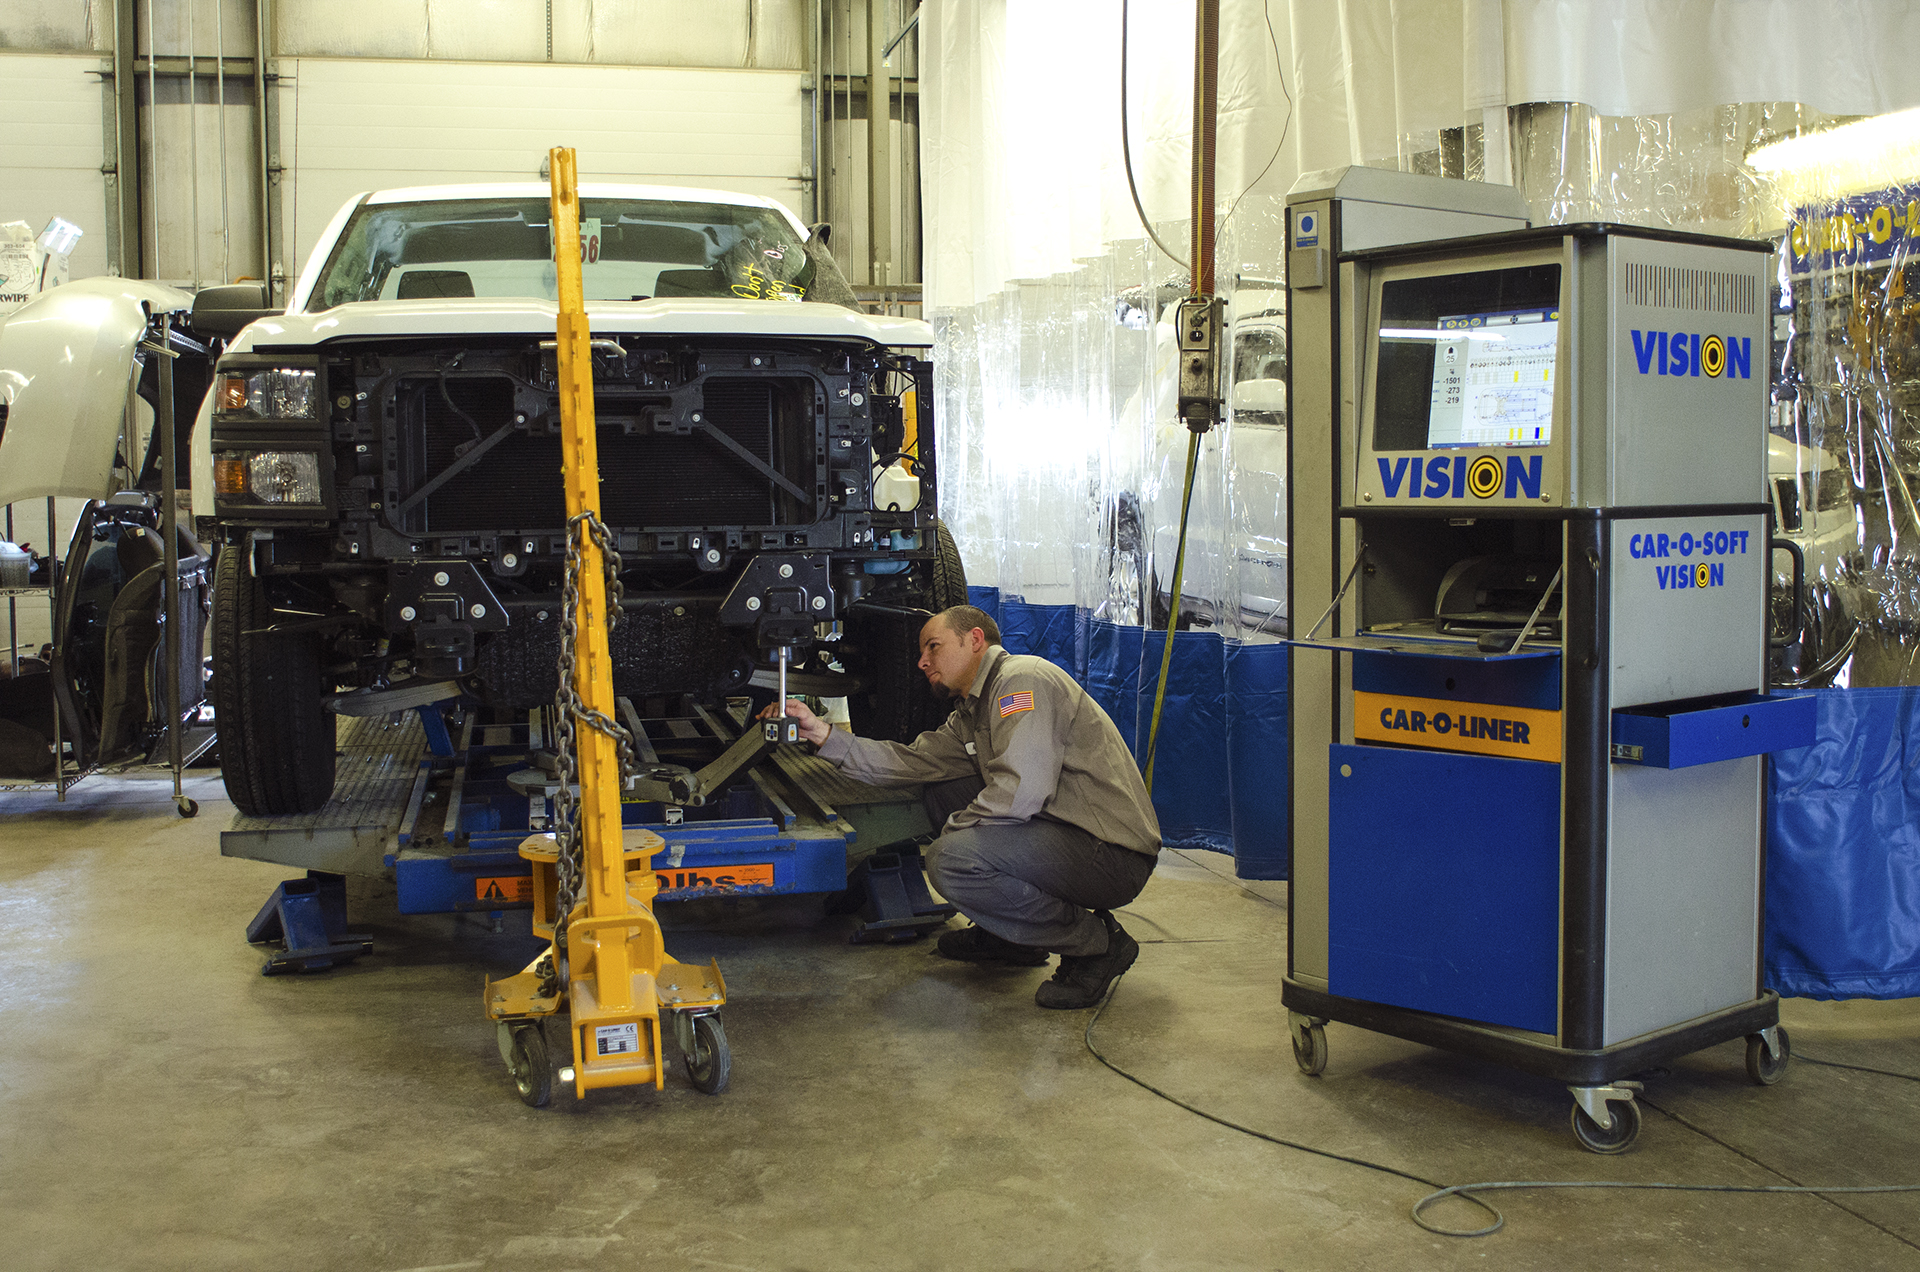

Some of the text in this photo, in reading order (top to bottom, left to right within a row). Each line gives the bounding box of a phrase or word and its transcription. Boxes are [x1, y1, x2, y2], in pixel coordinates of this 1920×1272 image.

[1630, 330, 1751, 379] VISION
[1443, 376, 1461, 385] -1501
[1377, 455, 1543, 499] VISION
[1630, 530, 1749, 559] CAR-O-SOFT
[1656, 563, 1724, 590] VISION
[1380, 707, 1531, 744] CAR-O-LINER
